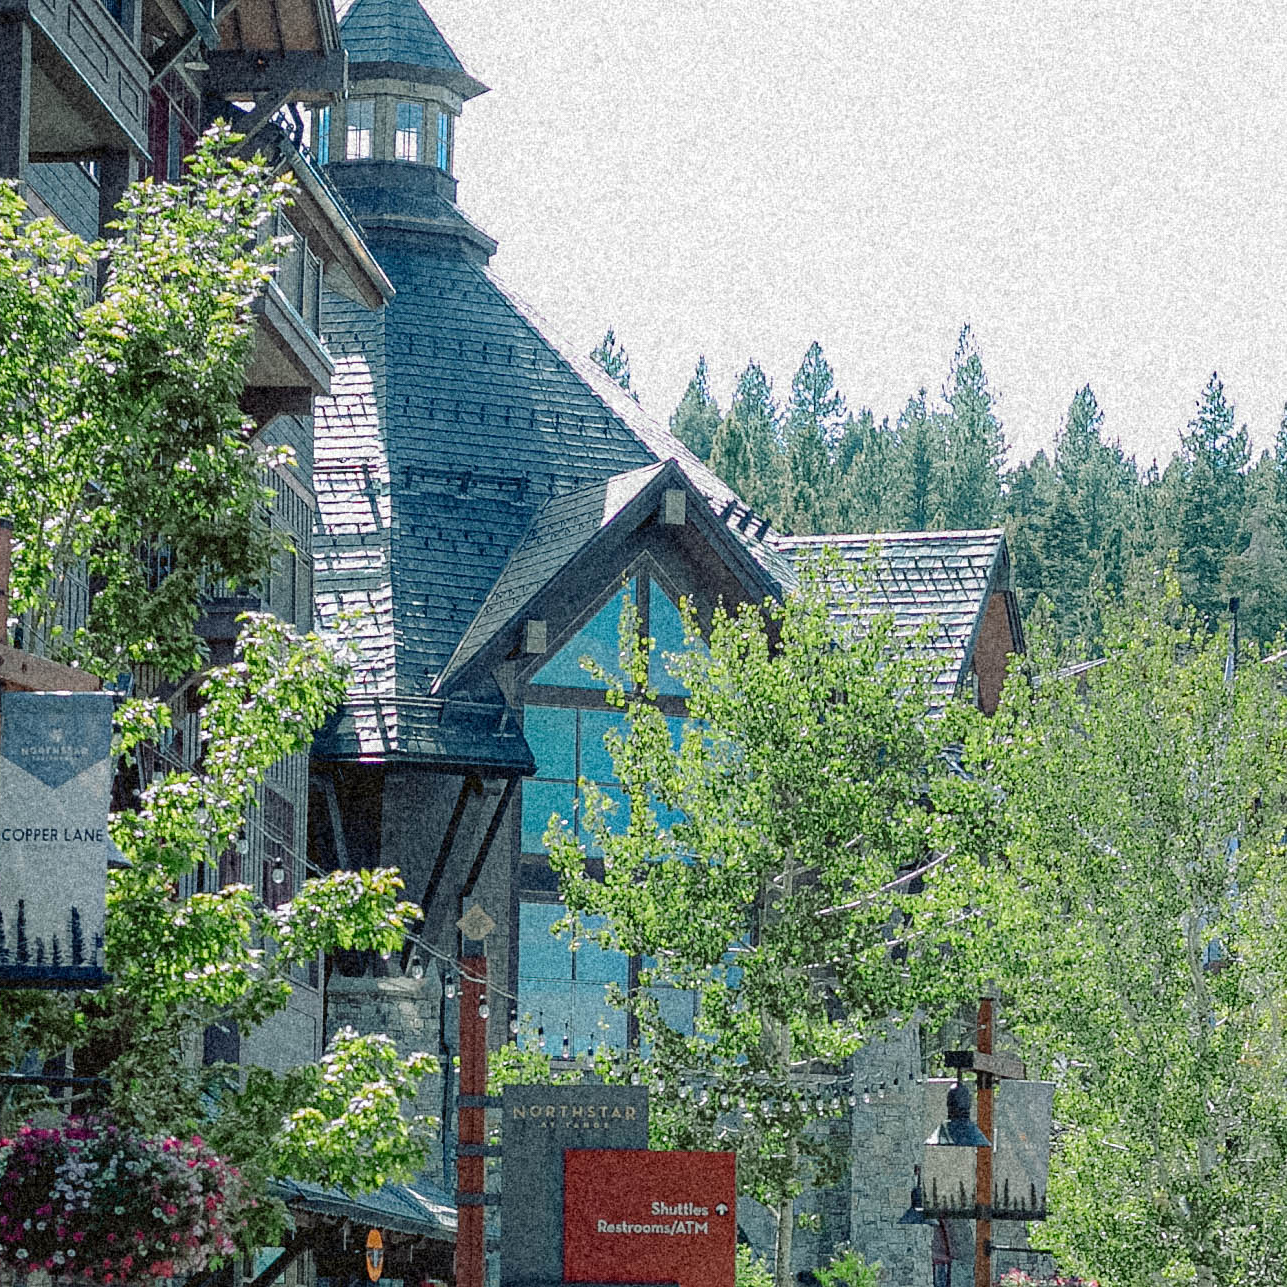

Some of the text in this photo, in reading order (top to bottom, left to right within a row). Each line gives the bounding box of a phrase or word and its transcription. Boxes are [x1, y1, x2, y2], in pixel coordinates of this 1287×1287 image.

[1, 828, 104, 842] COPPER LANE
[512, 1104, 637, 1121] NORTHSTAR
[565, 1121, 610, 1129] TAHOE
[651, 1201, 709, 1217] Shuttles
[596, 1219, 709, 1236] Restrooms/ATM
